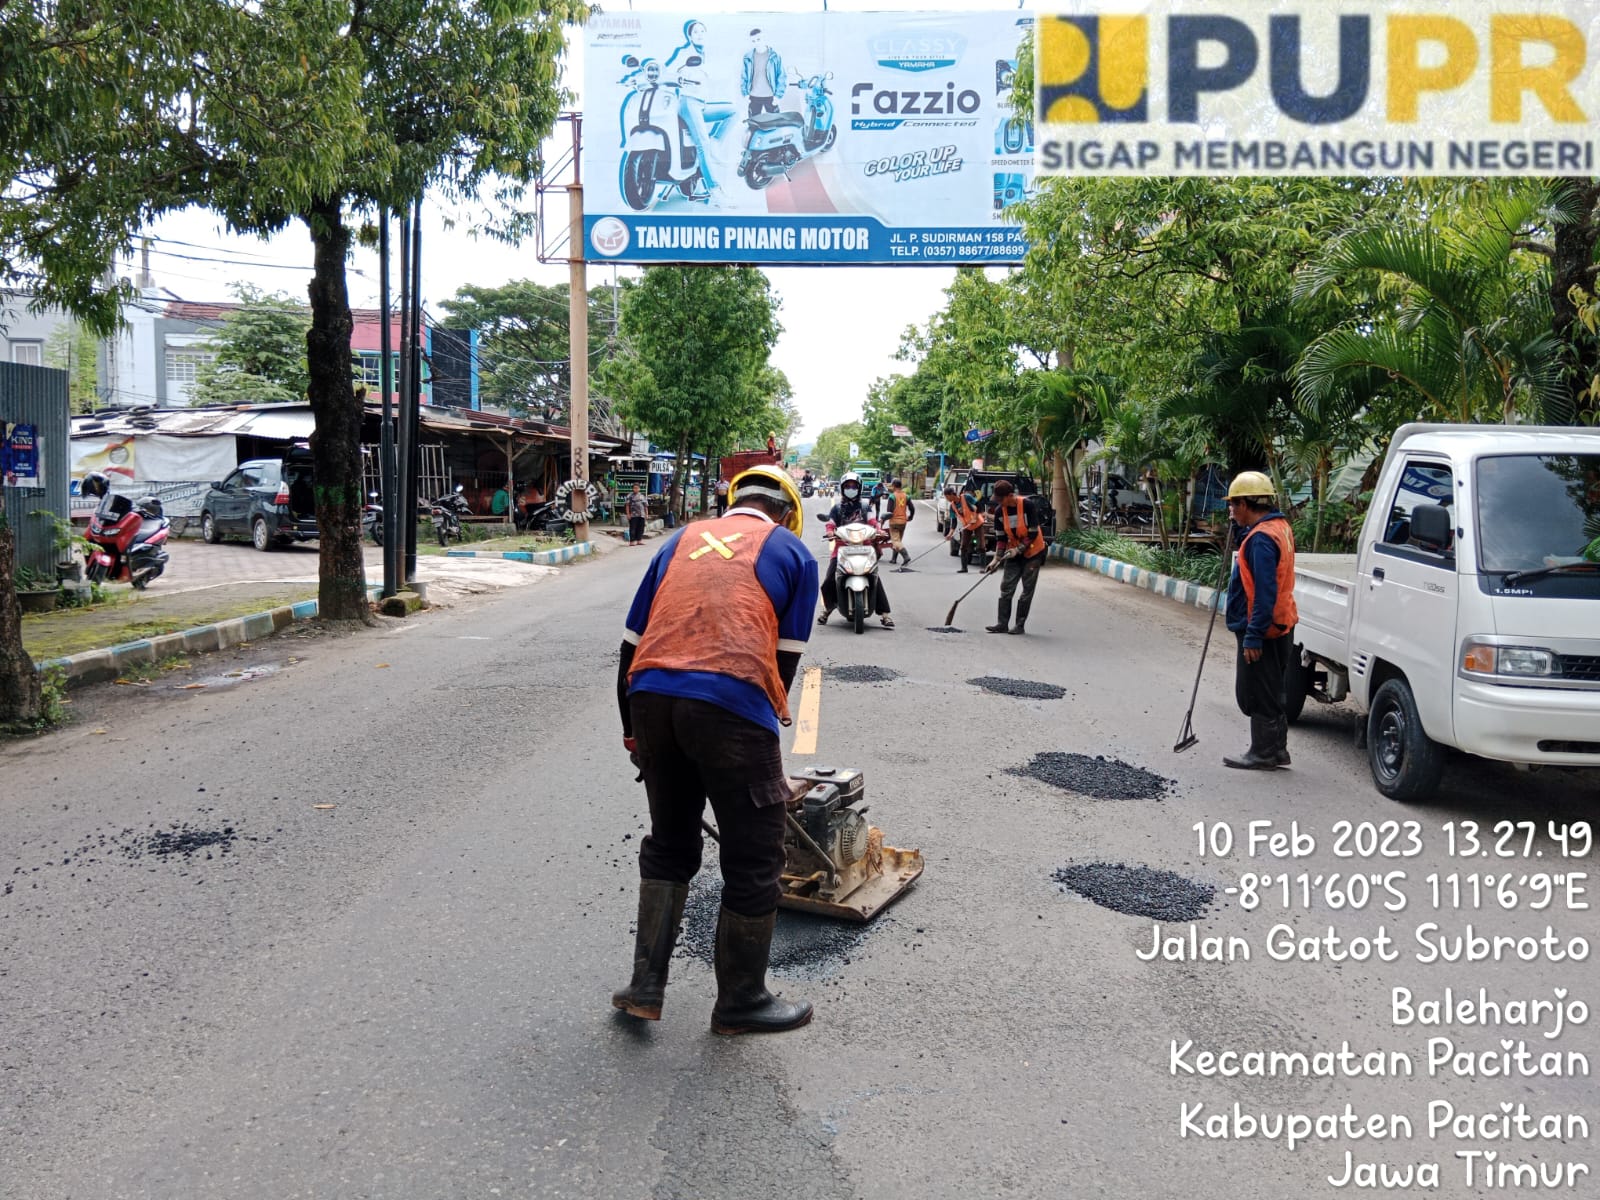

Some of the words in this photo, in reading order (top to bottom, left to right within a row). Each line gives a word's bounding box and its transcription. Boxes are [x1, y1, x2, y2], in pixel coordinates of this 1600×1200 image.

[873, 39, 960, 53] CLASSY
[851, 81, 981, 115] Fazzio
[854, 121, 896, 129] Hybrid
[902, 120, 977, 128] Connected
[864, 151, 927, 177] COLOR
[930, 145, 957, 164] UP
[894, 165, 931, 183] YOUR
[931, 158, 963, 176] LIFE
[635, 226, 720, 249] TANJUNG
[724, 227, 796, 250] PINANG
[800, 227, 869, 250] MOTOR
[890, 233, 906, 243] JL.
[910, 233, 918, 243] P.
[922, 233, 981, 243] SUDIRMAN
[985, 232, 1003, 243] 158
[890, 246, 921, 256] TELP.
[923, 245, 956, 257] (0357)
[652, 462, 670, 472] PULSA
[563, 509, 594, 523] BAN
